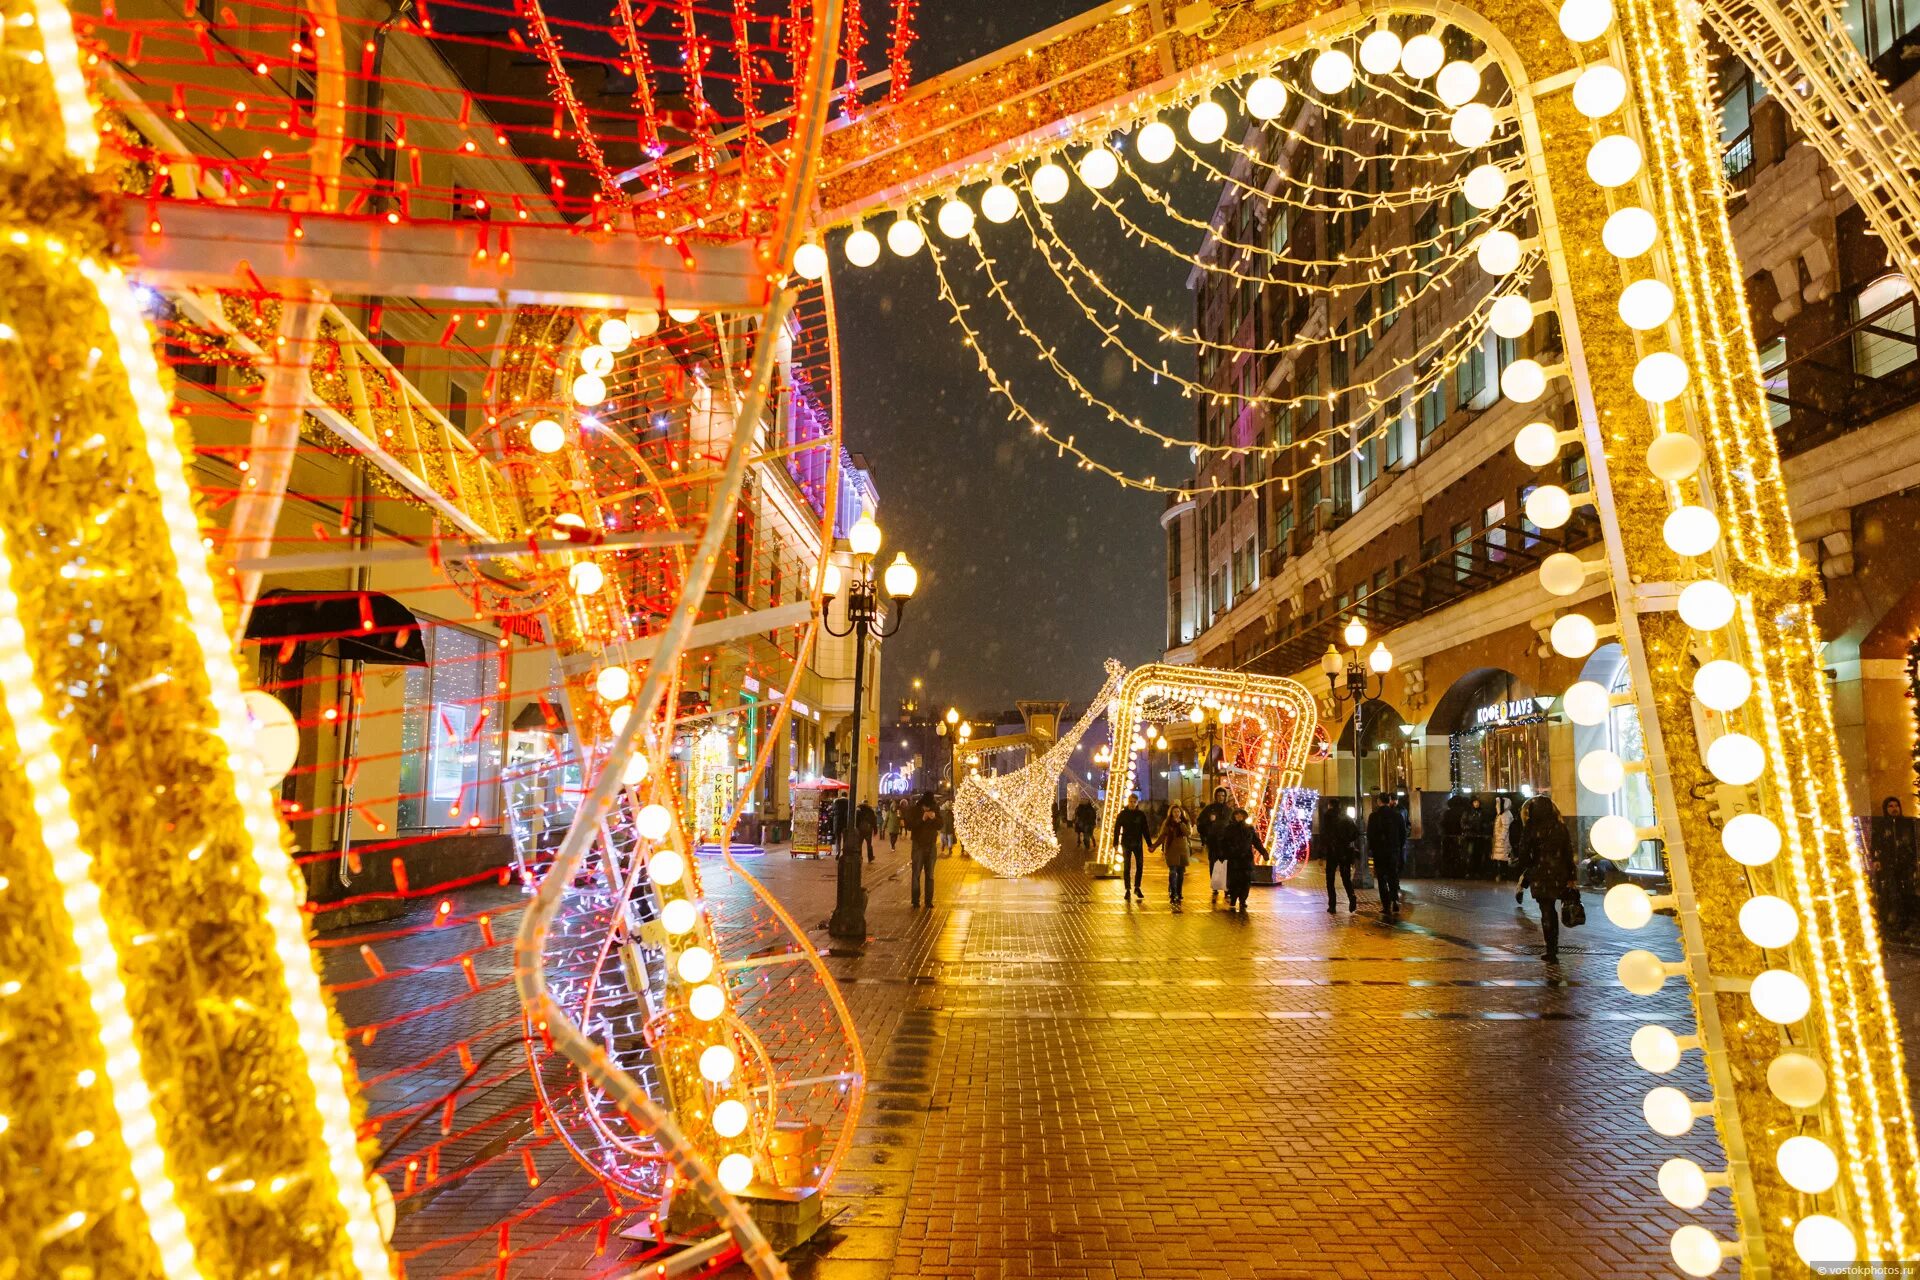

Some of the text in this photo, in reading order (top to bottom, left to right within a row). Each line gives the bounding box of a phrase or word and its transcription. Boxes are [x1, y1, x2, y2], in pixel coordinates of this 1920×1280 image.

[1477, 697, 1533, 723] КОФЕ ХАУЗ
[714, 773, 723, 837] СКУПКА
